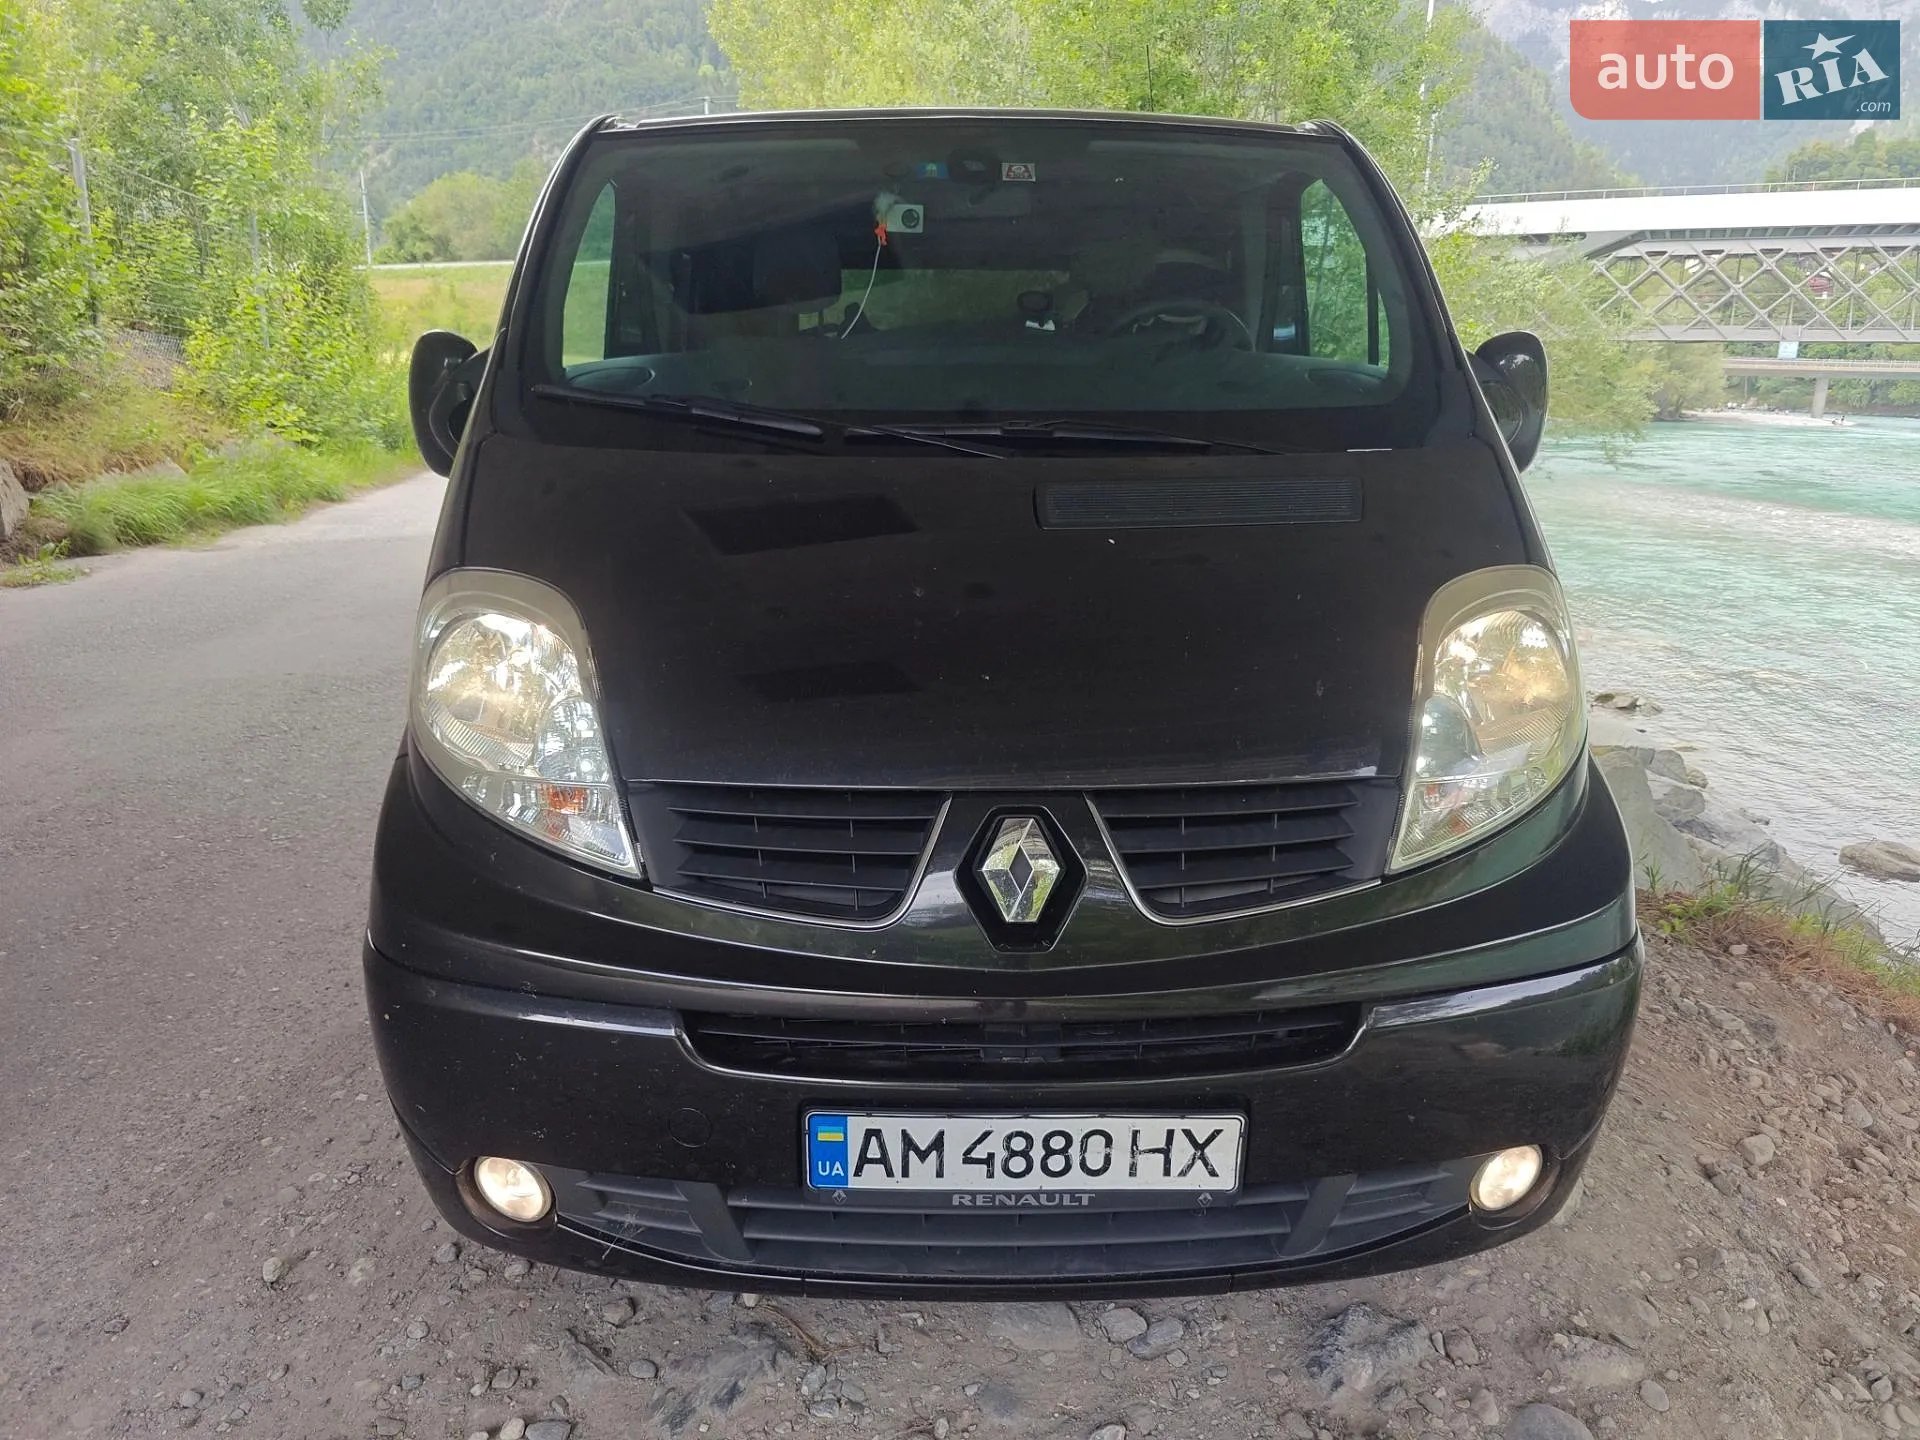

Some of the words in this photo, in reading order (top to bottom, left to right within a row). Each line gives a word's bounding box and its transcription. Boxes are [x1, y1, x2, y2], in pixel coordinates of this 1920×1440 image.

[853, 1128, 945, 1178] AM
[961, 1129, 1114, 1179] 4880
[1127, 1128, 1225, 1178] HX
[818, 1161, 844, 1177] UA
[951, 1193, 1096, 1206] RENAULT
